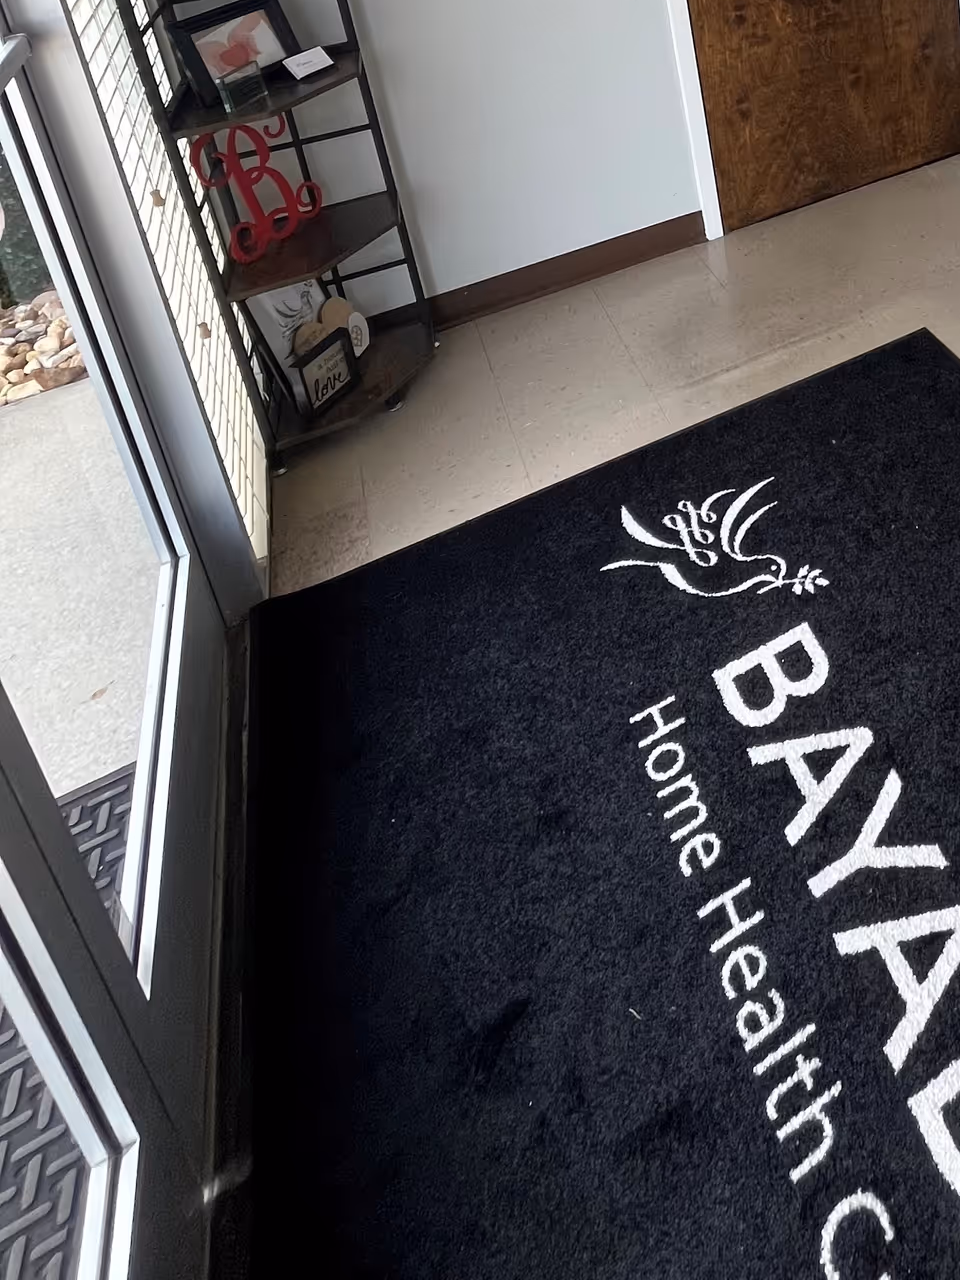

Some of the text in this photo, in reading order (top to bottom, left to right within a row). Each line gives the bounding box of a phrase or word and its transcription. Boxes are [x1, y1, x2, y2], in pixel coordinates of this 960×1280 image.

[312, 371, 349, 406] love
[629, 695, 843, 1184] Home Health
